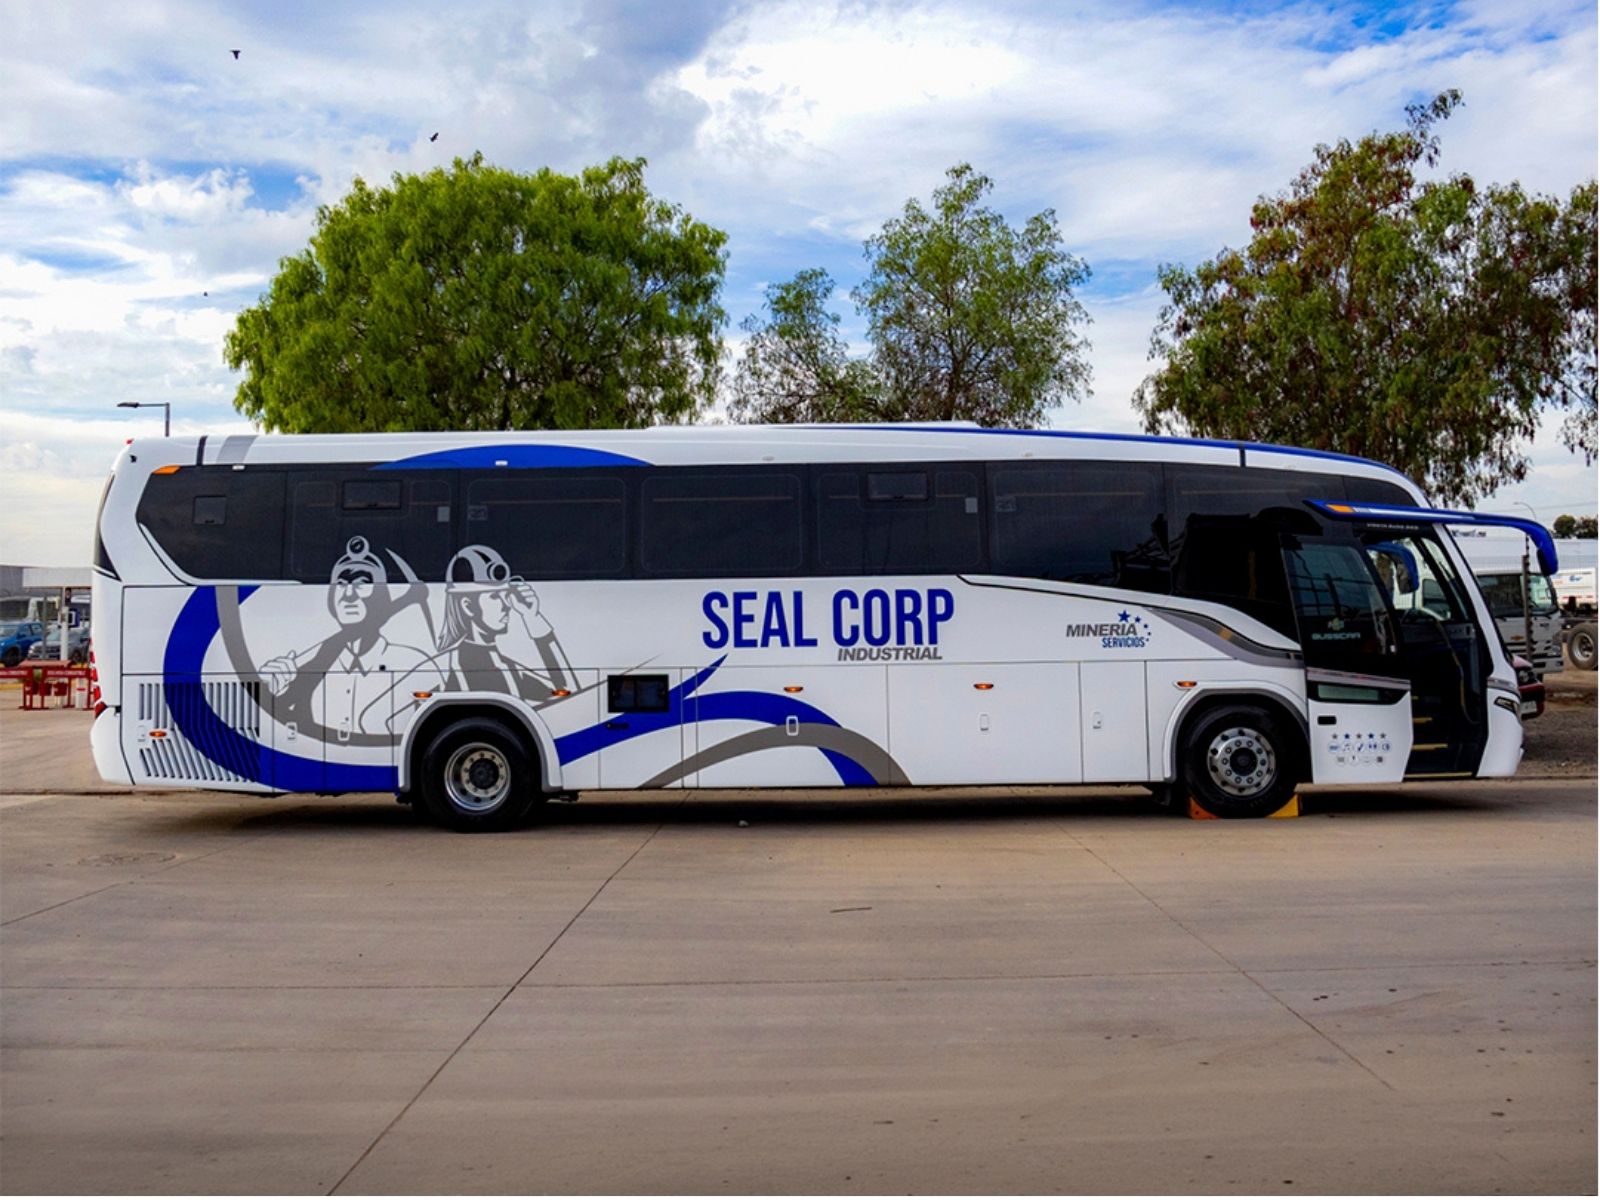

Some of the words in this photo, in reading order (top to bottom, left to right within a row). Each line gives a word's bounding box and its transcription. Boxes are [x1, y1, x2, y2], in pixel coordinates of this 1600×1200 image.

[702, 591, 818, 649] SEAL
[832, 588, 954, 647] CORP
[1066, 623, 1137, 637] MINERIA
[1102, 636, 1145, 648] SERVICIOS
[837, 647, 943, 662] INDUSTRIAL
